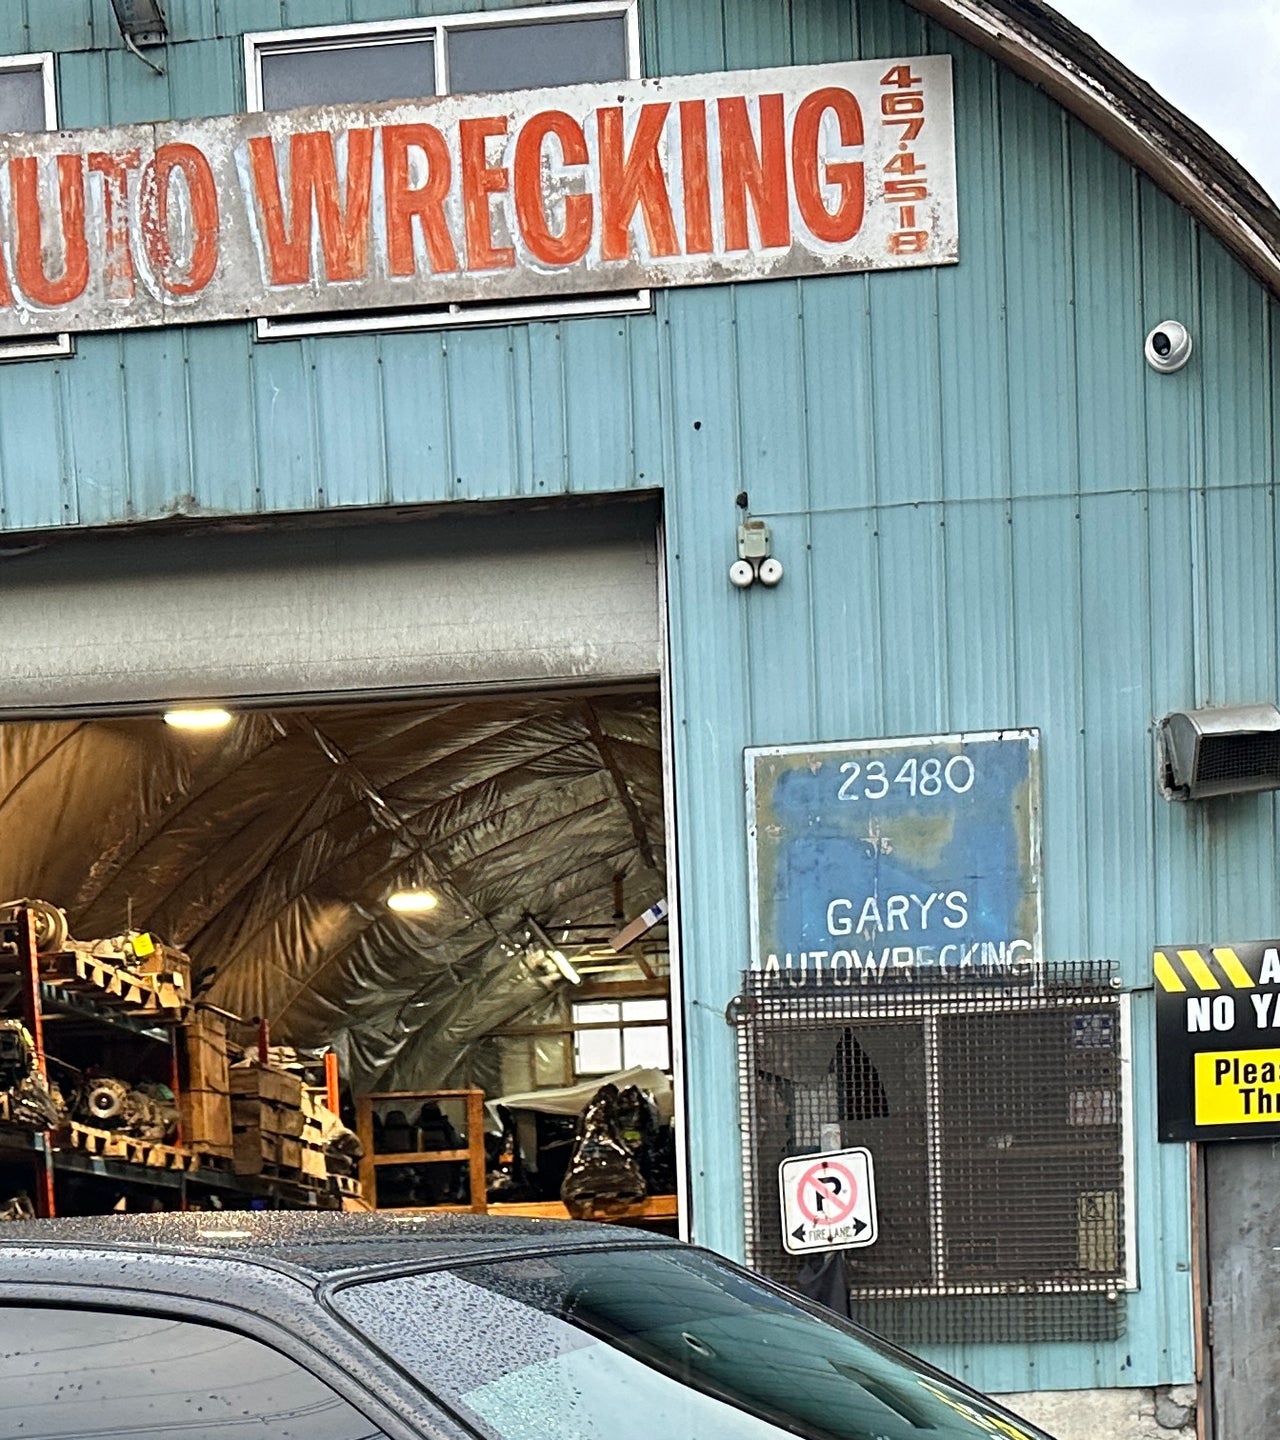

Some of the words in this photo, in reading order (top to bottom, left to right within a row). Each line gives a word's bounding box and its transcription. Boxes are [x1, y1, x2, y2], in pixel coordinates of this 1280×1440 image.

[248, 86, 866, 286] WRECKING
[837, 755, 975, 801] 23480
[826, 891, 968, 936] GARY'S
[1187, 996, 1235, 1033] NO
